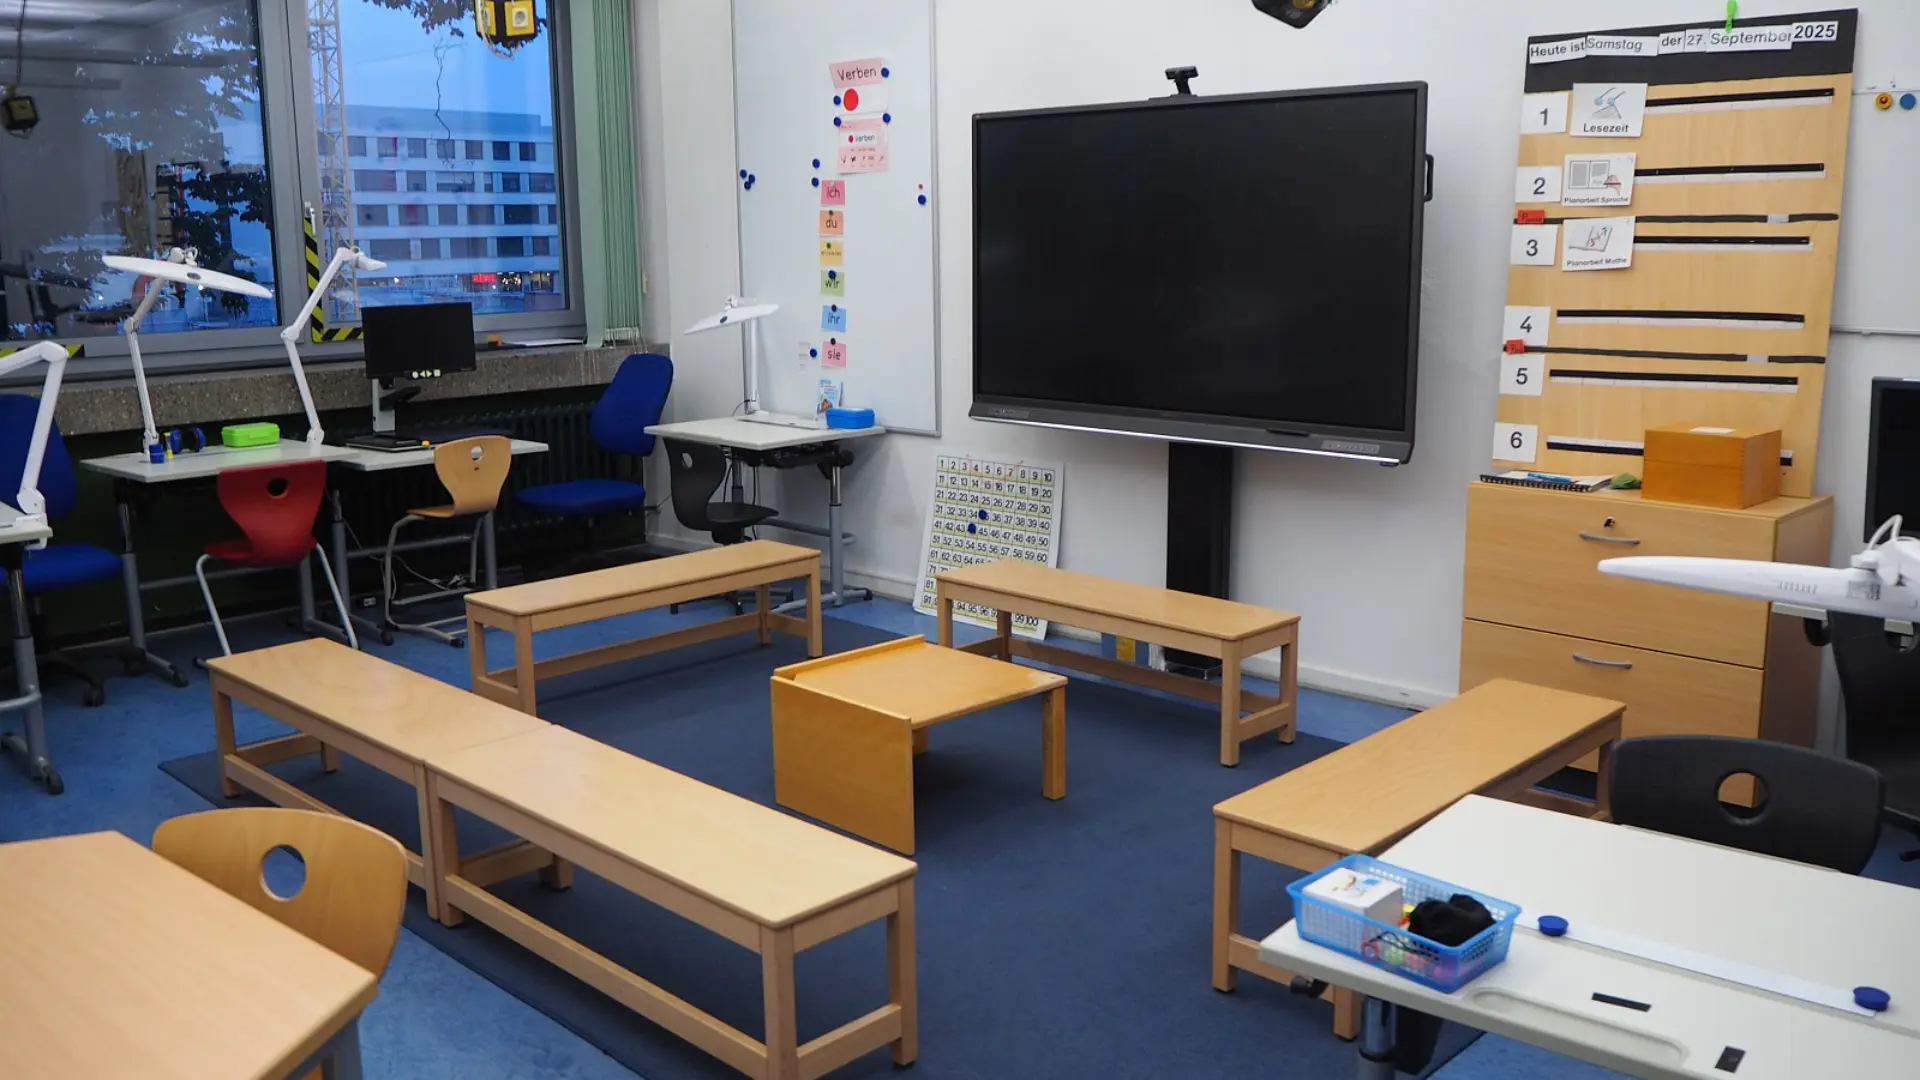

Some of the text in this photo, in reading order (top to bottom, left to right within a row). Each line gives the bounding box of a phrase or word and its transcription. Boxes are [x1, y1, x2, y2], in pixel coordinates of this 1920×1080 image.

[1530, 45, 1567, 57] Heute
[1570, 41, 1585, 53] ist
[1587, 37, 1643, 52] Samstag
[1661, 35, 1682, 47] der
[1687, 34, 1707, 46] 27.
[1794, 24, 1836, 39] 2025
[836, 67, 877, 82] Verben
[1540, 107, 1548, 126] 1
[1583, 123, 1629, 133] Lesezeit
[826, 184, 841, 199] ich
[1533, 176, 1546, 195] 2
[825, 216, 838, 229] du
[1526, 239, 1538, 257] 3
[825, 279, 840, 289] wir
[827, 312, 840, 324] ihr
[1520, 315, 1532, 333] 4
[827, 348, 841, 361] sie
[1515, 367, 1528, 385] 5
[1510, 431, 1523, 449] 6
[951, 460, 956, 470] 2
[963, 462, 966, 470] 3
[974, 464, 978, 472] 4
[985, 465, 990, 474] 5
[997, 467, 1002, 475] 6
[1009, 468, 1013, 476] 7
[1021, 470, 1025, 478] 8
[1032, 471, 1037, 480] 9
[1044, 473, 1052, 482] 10
[939, 475, 944, 483] 11
[950, 476, 956, 484] 12
[960, 477, 967, 486] 13
[972, 479, 978, 488] 14
[1008, 484, 1014, 492] 17
[1019, 486, 1026, 494] 18
[1032, 487, 1038, 496] 19
[1042, 488, 1051, 498] 20
[937, 490, 1050, 514] 21 22 23 24 25 26 27 28 29 30
[936, 505, 942, 513] 31
[947, 506, 955, 515] 32
[959, 508, 966, 517] 33
[969, 509, 977, 518] 34
[992, 513, 1001, 522] 36
[1004, 515, 1013, 524] 37
[1015, 516, 1025, 526] 38
[1027, 518, 1037, 527] 39
[1040, 521, 1049, 530] 40
[935, 520, 1048, 546] 41 42 43 45 46 47 48 49 50
[930, 550, 938, 558] 61
[942, 552, 950, 560] 62
[953, 554, 961, 562] 63
[964, 556, 972, 565] 64
[932, 535, 1047, 562] 51 52 53 54 55 56 57 58 59 60
[930, 564, 936, 573] 71
[926, 580, 934, 588] 81
[924, 595, 931, 604] 91
[1015, 614, 1024, 623] 99
[1026, 616, 1038, 626] 100
